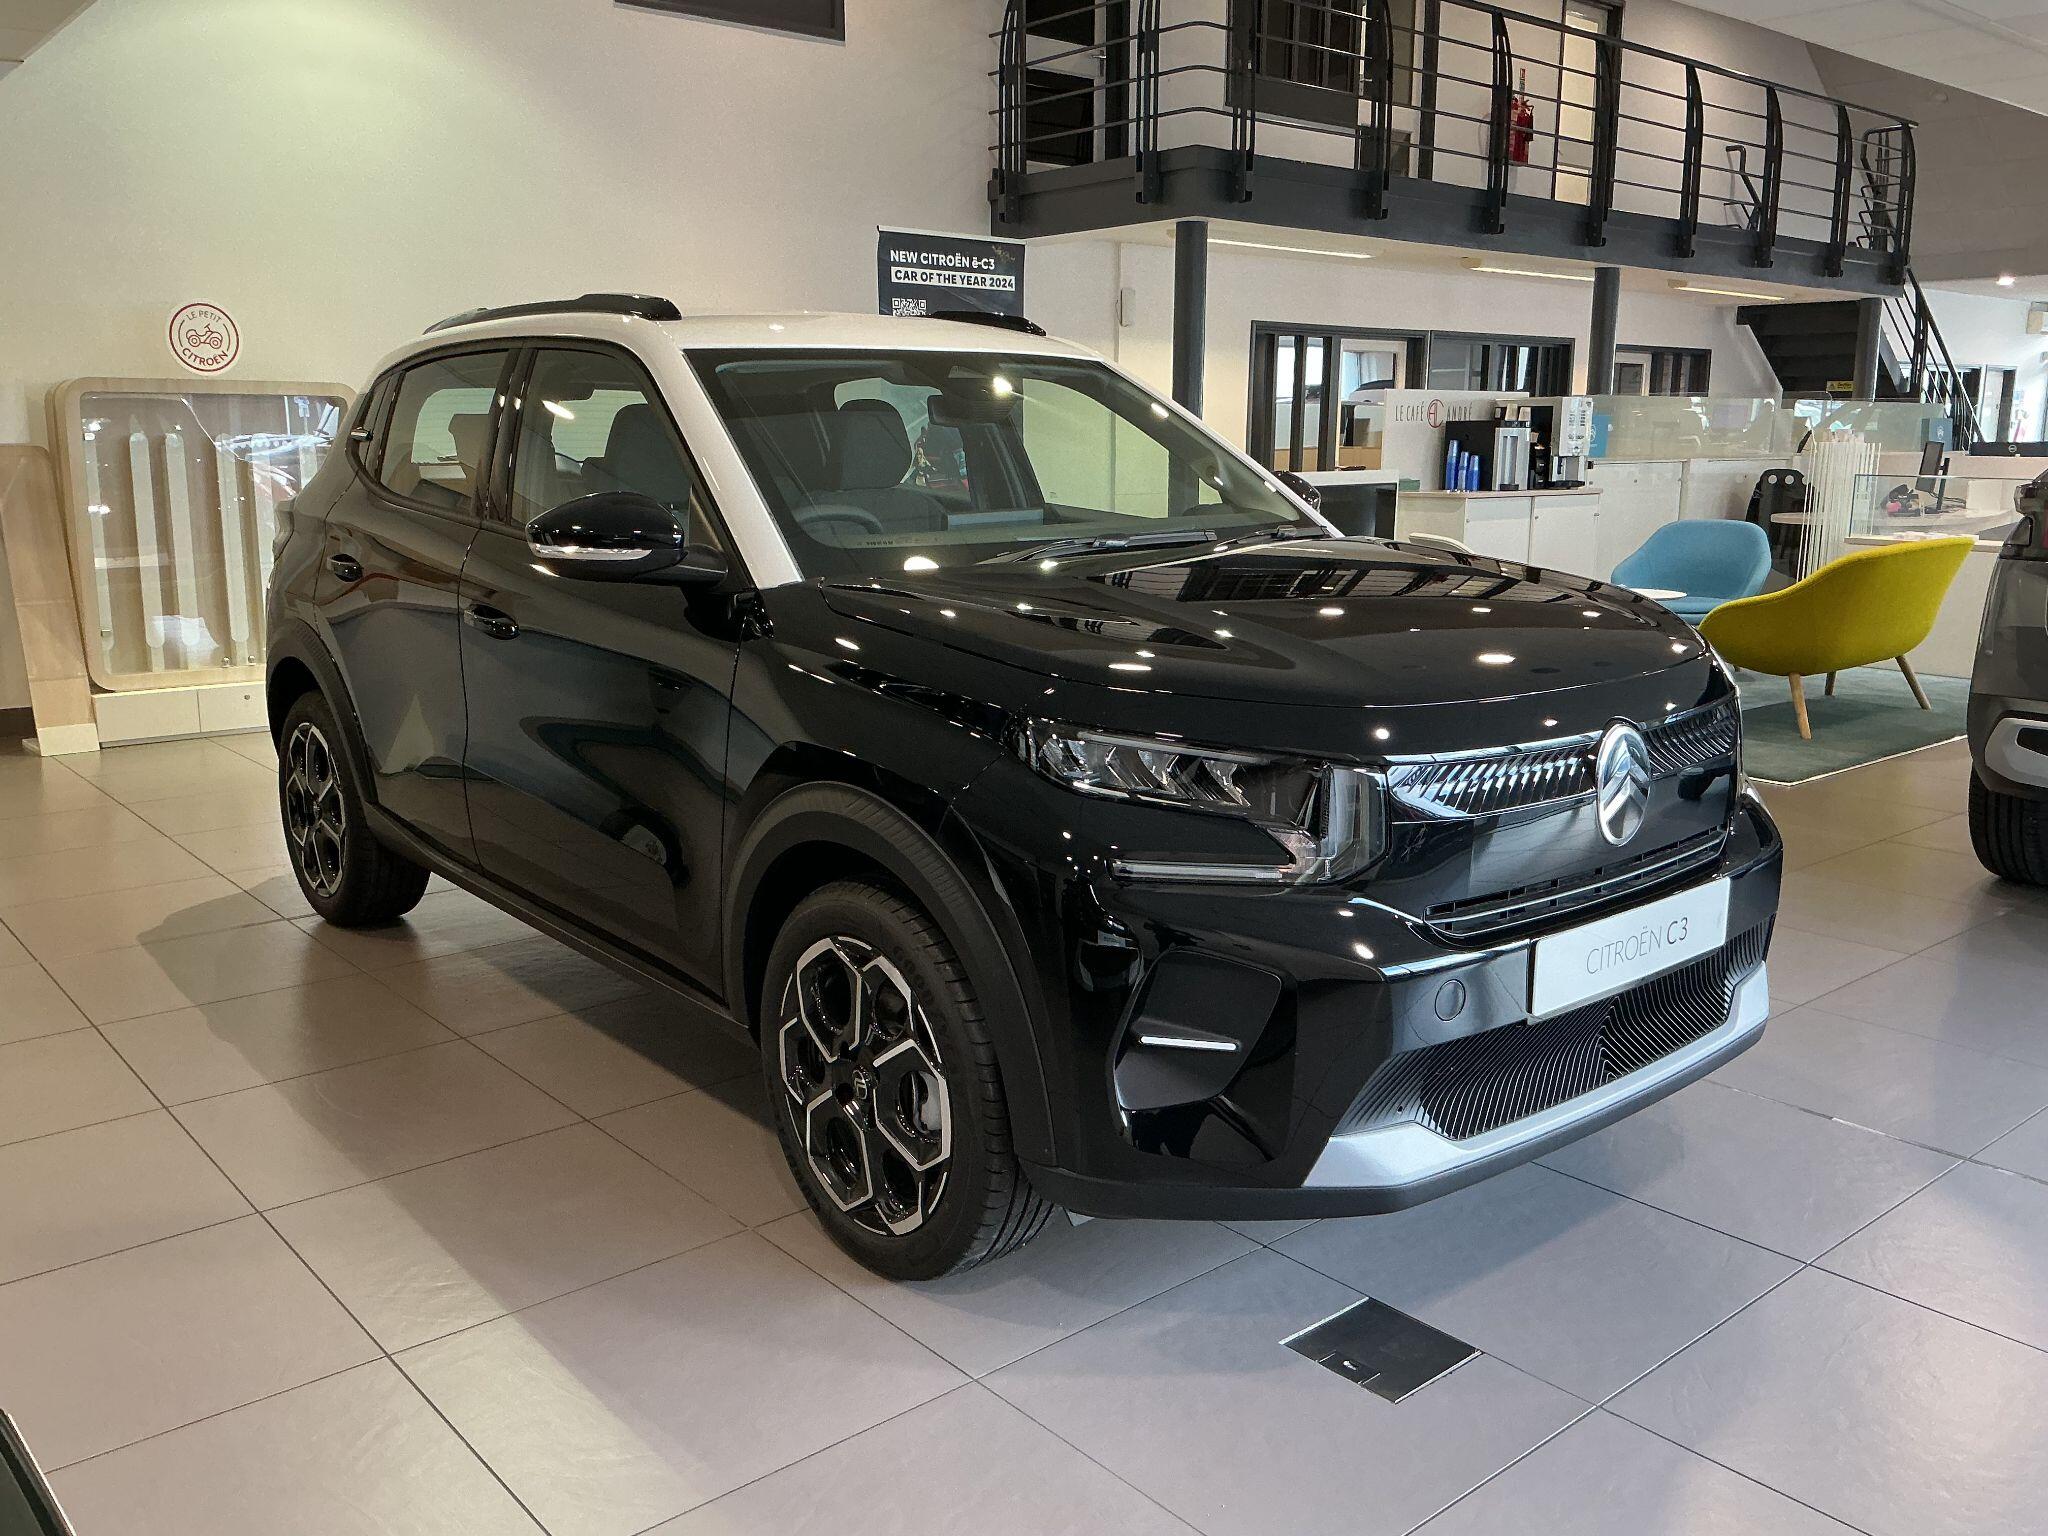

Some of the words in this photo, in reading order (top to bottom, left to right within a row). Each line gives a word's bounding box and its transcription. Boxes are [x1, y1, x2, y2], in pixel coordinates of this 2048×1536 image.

[890, 250, 917, 264] NEW
[920, 253, 969, 268] CITROËN
[895, 270, 918, 281] CAR
[920, 271, 934, 283] OF
[935, 273, 957, 285] THE
[959, 275, 987, 287] YEAR
[989, 277, 1014, 289] 2024
[186, 311, 198, 321] LE
[199, 310, 222, 323] PETIT
[1395, 405, 1404, 421] LE
[1406, 401, 1424, 421] CAFÉ
[1446, 402, 1473, 421] ANDRÉ
[1586, 926, 1662, 974] CITROËN
[1666, 917, 1688, 944] C3
